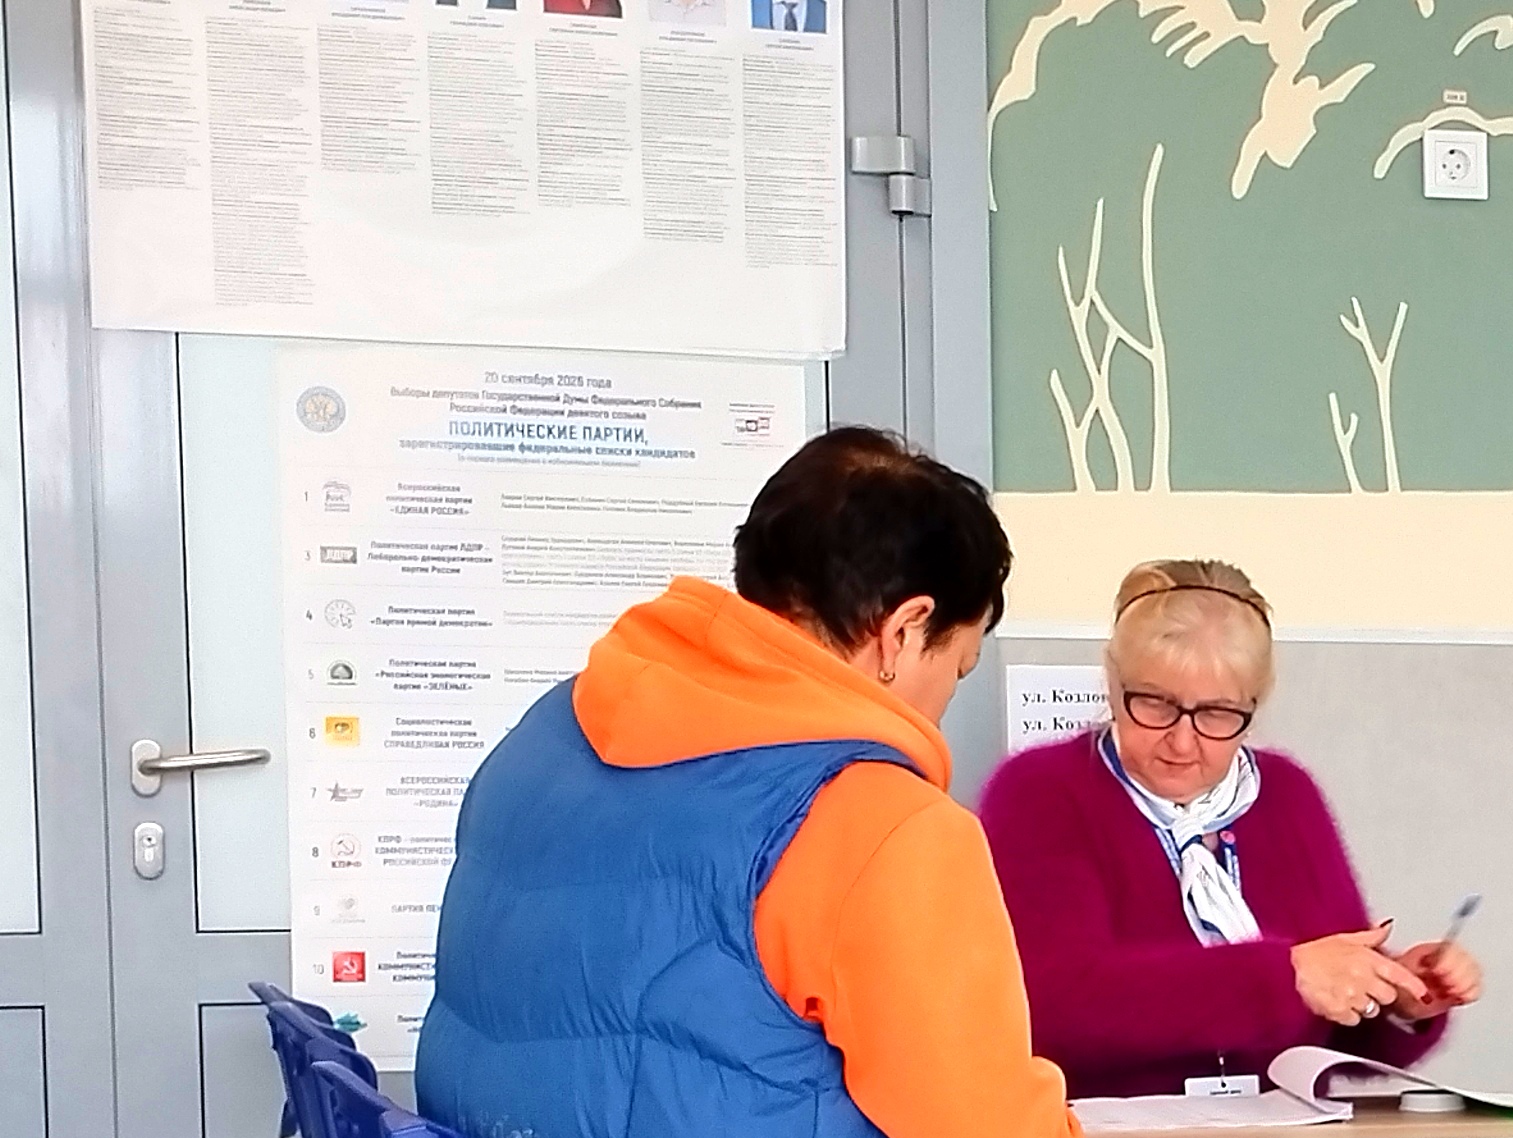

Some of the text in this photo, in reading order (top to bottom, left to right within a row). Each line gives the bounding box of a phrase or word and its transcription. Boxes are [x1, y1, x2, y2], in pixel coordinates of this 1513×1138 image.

[501, 373, 554, 387] сентября
[586, 377, 612, 389] года
[448, 421, 649, 446] ПОЛИТИЧЕСКИЕ ПАРТИИ,
[634, 448, 696, 459] кандидатов
[304, 492, 308, 502] 1
[306, 610, 312, 620] 4
[308, 669, 314, 680] 5
[1021, 693, 1046, 707] ул.
[1022, 720, 1048, 734] ул.
[309, 728, 316, 740] 6
[311, 788, 317, 798] 7
[410, 836, 452, 844] политичес
[312, 846, 319, 858] 8
